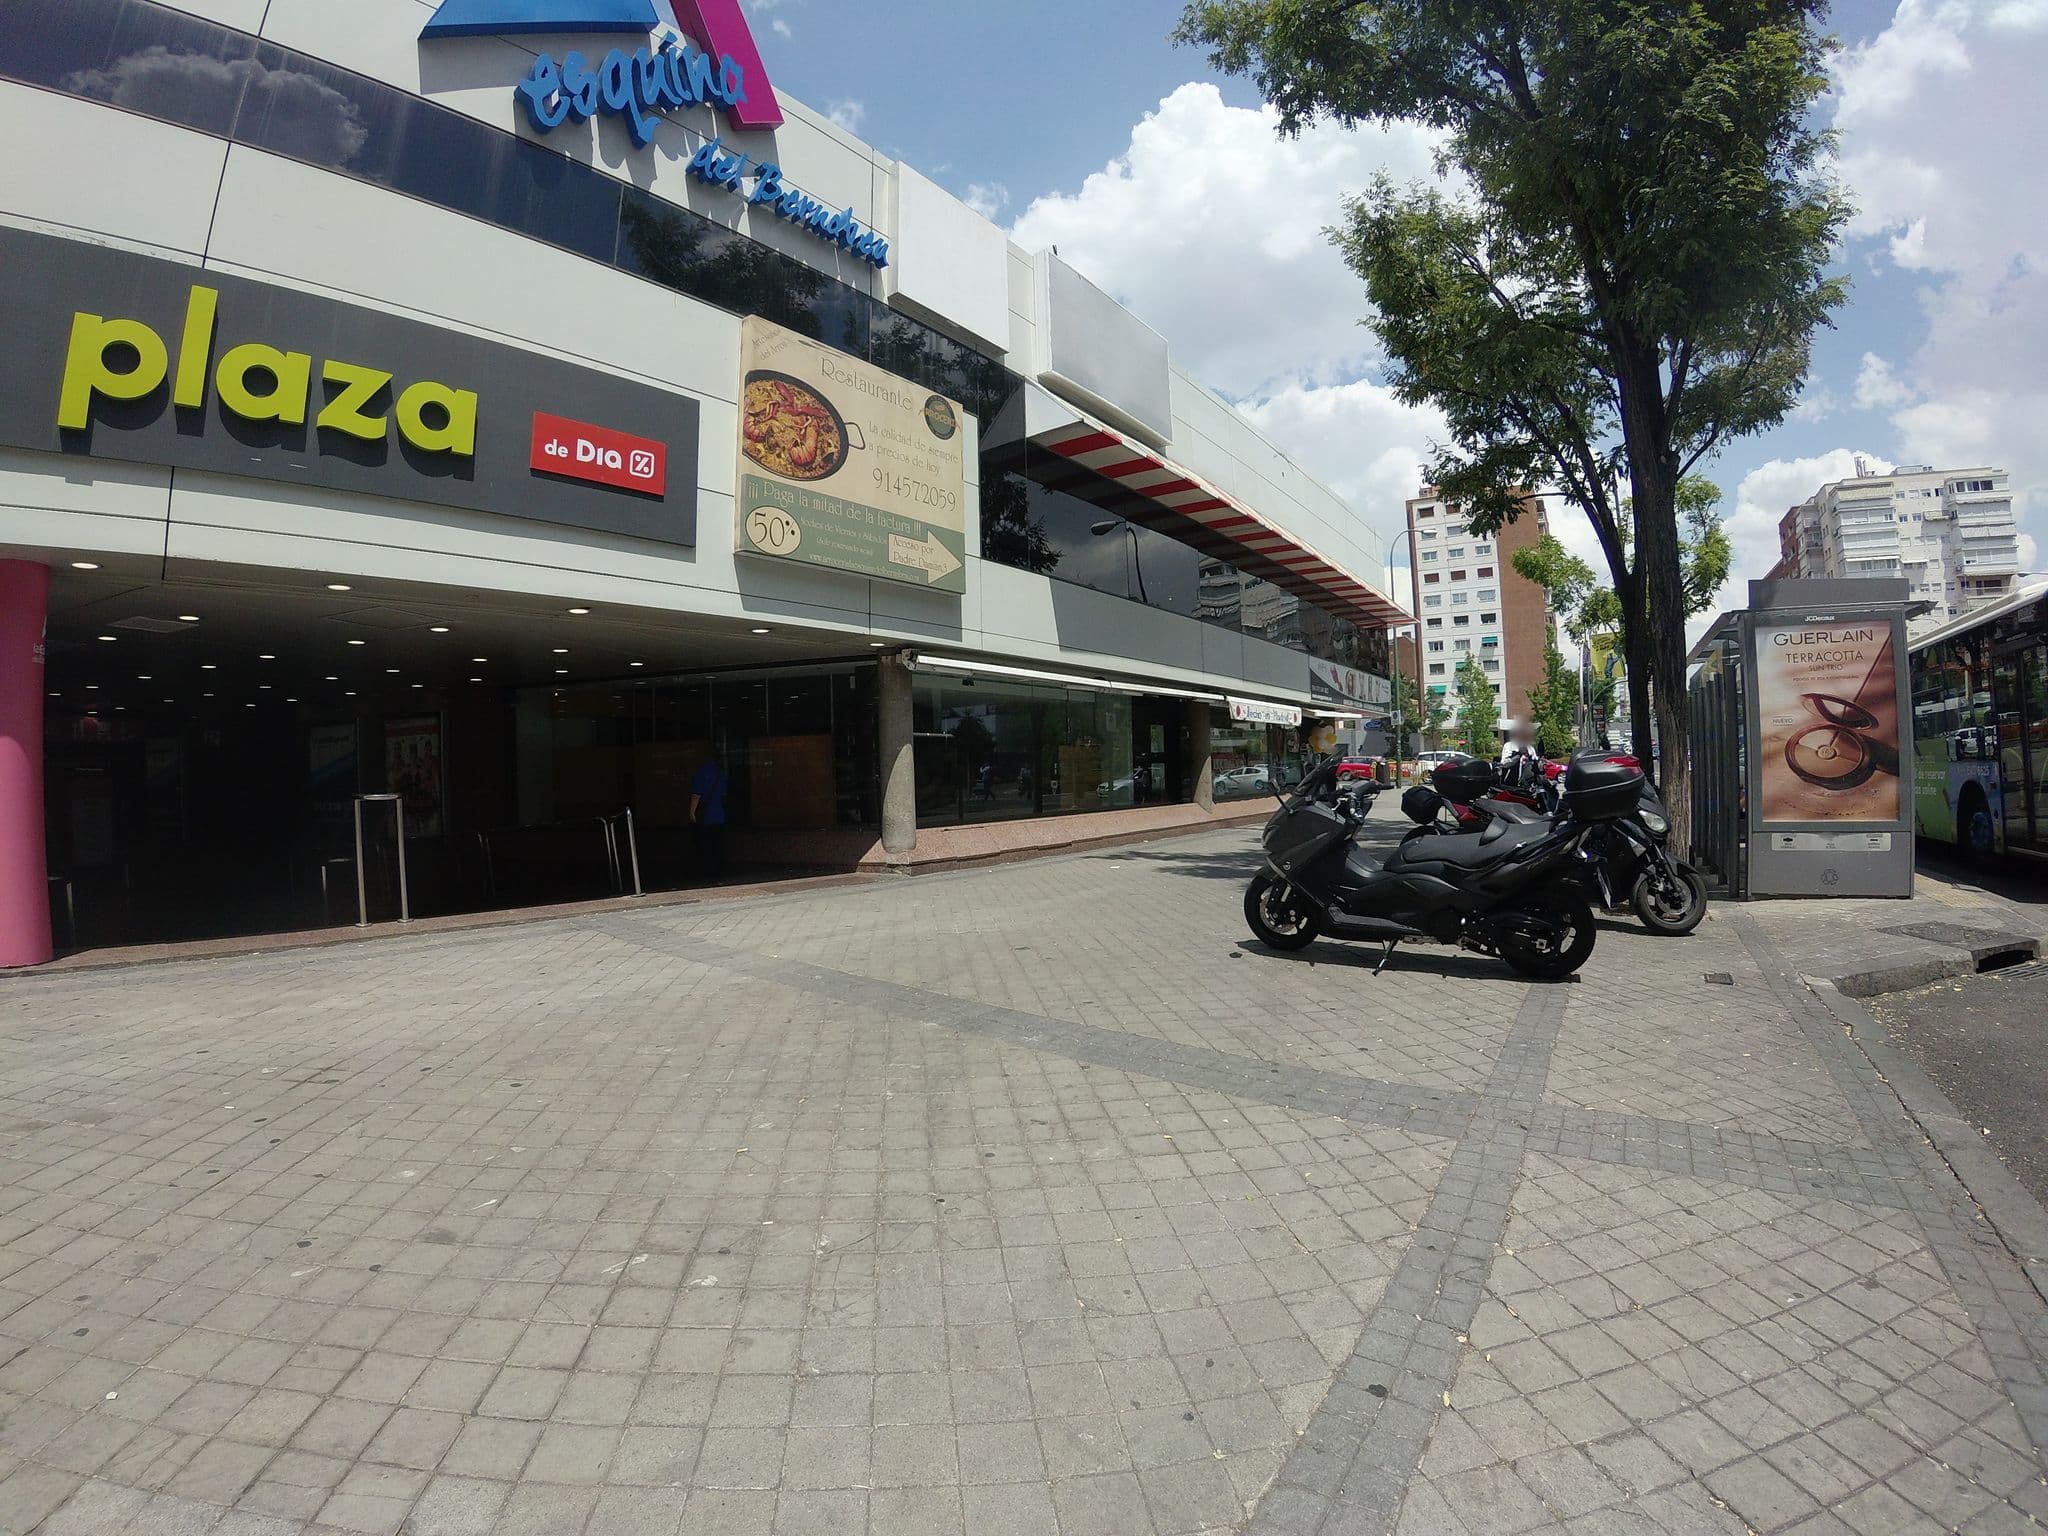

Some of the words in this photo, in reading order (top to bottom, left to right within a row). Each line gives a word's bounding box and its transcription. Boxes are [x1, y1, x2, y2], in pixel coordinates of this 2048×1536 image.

[516, 31, 747, 148] esquina
[687, 137, 748, 192] del
[58, 285, 478, 456] plaza
[820, 357, 913, 412] Restaurante
[544, 438, 569, 458] de
[576, 438, 622, 470] Dia
[876, 445, 910, 464] precios
[912, 454, 925, 468] de
[926, 459, 940, 477] hoy
[881, 428, 912, 447] calidad
[914, 438, 927, 452] de
[928, 446, 960, 464] siempre
[763, 481, 795, 508] Paga
[799, 491, 808, 507] la
[812, 498, 842, 517] mitad
[846, 503, 862, 522] de
[865, 507, 874, 526] la
[877, 510, 911, 534] factura
[872, 467, 957, 512] 914572059
[753, 511, 796, 548] 50%
[893, 534, 920, 552] Acceso
[921, 544, 935, 557] por
[893, 551, 916, 566] Padre
[1773, 629, 1874, 646] GUERLAIN
[1786, 650, 1864, 664] TERRACOTTA
[1808, 664, 1825, 672] SUN
[1827, 663, 1844, 671] TRIO
